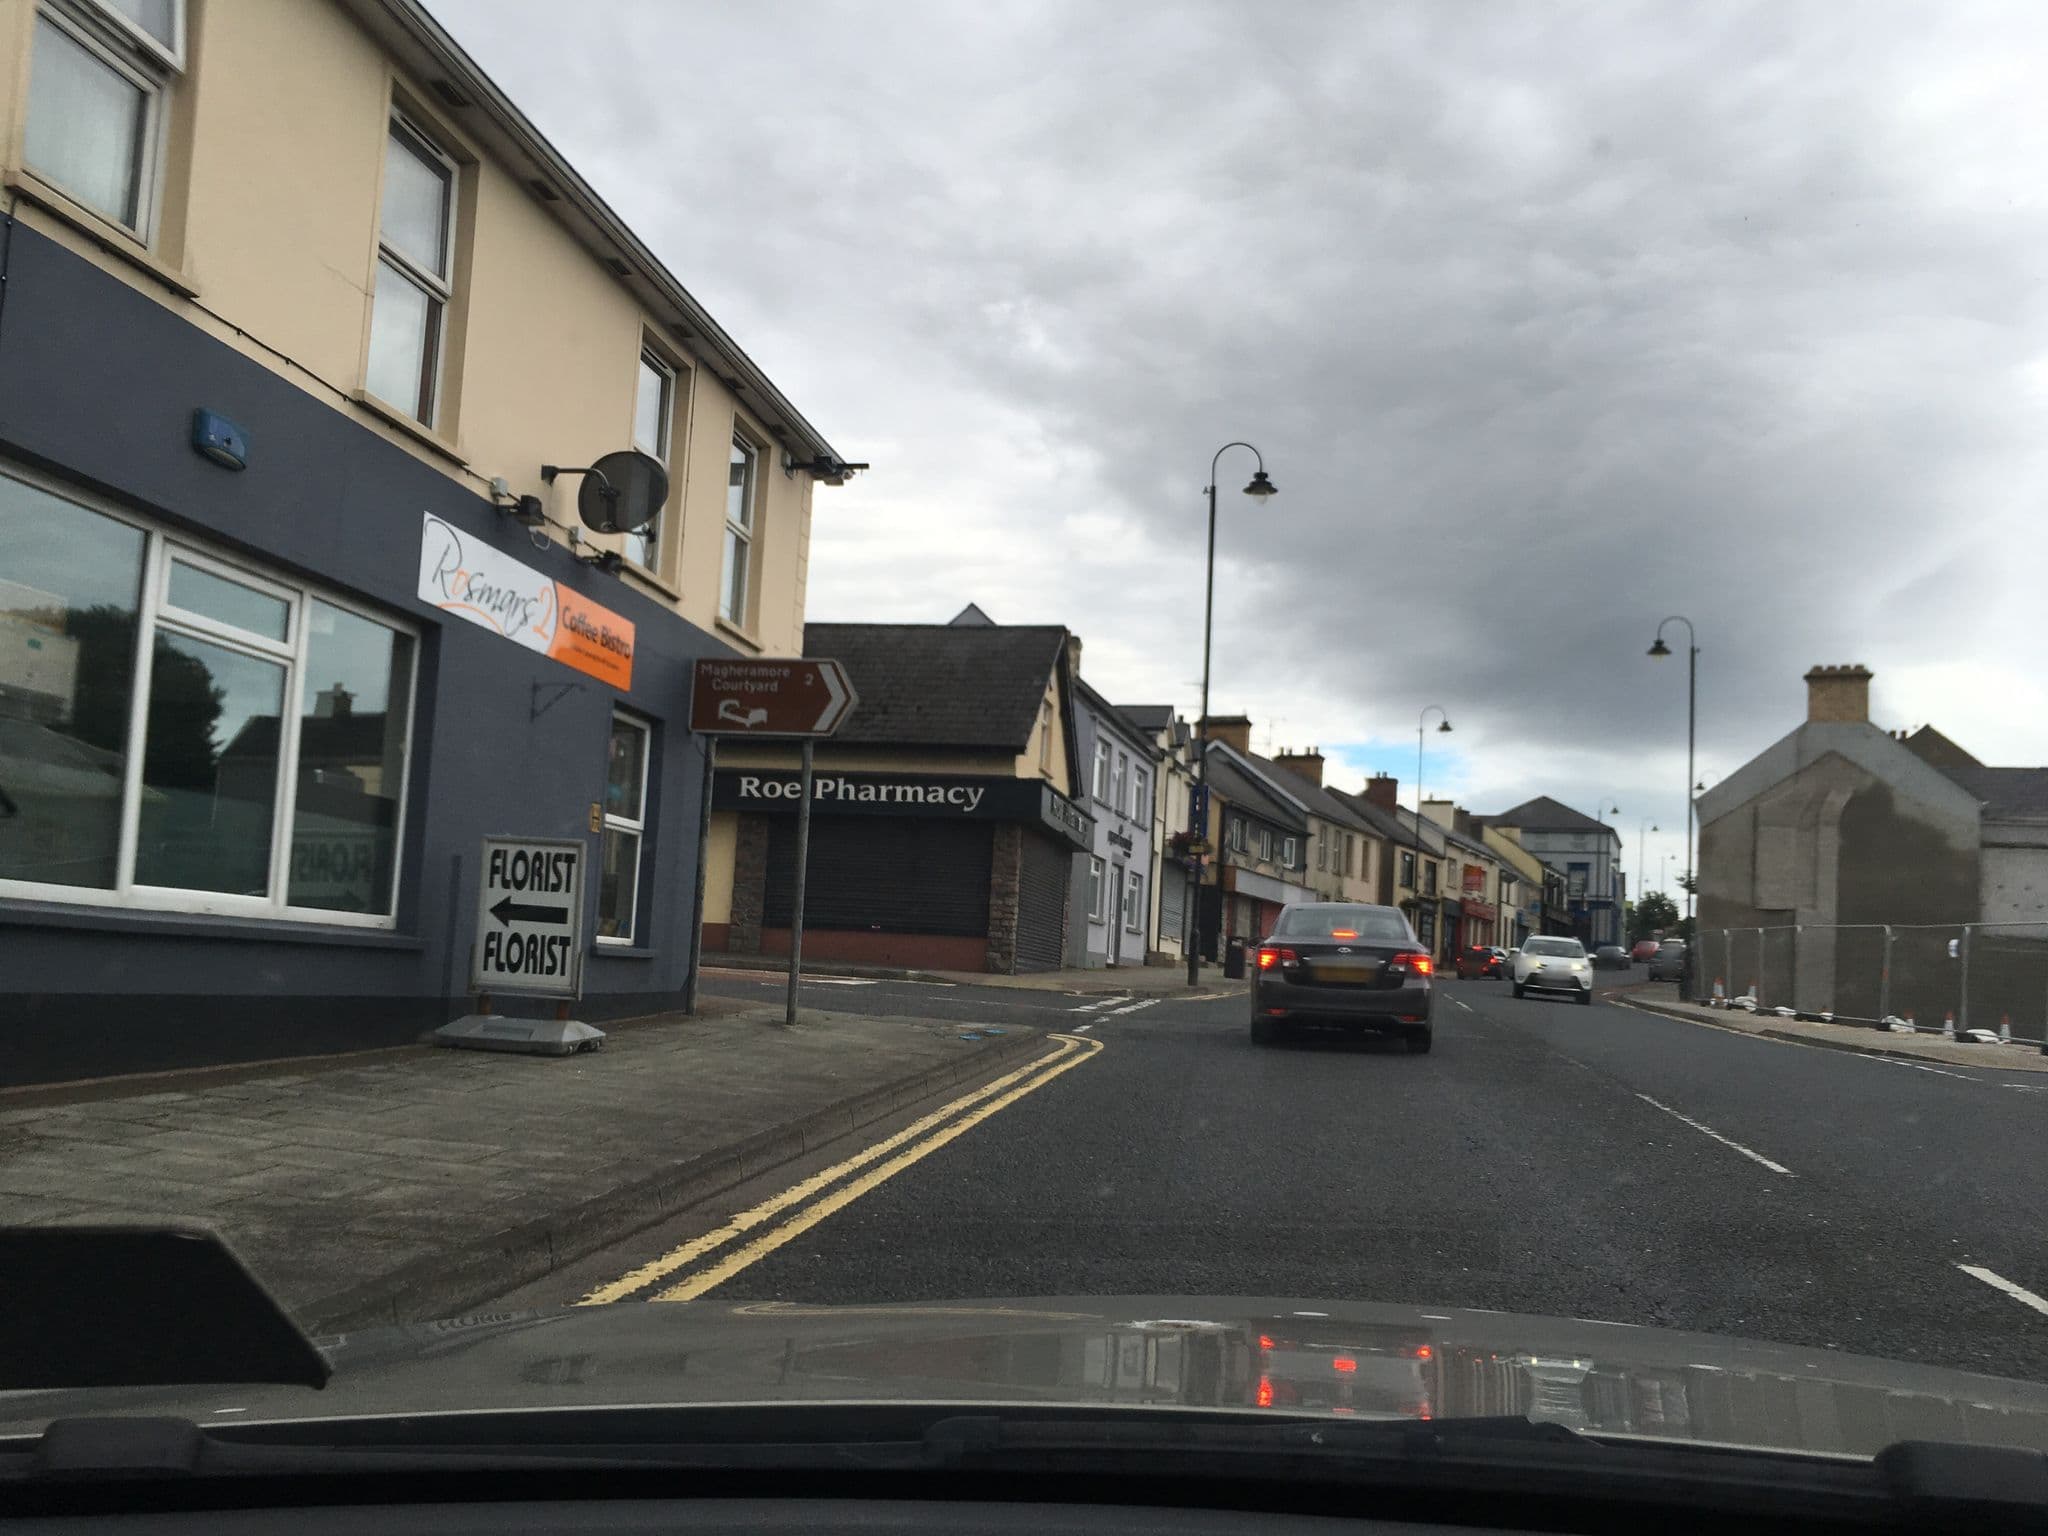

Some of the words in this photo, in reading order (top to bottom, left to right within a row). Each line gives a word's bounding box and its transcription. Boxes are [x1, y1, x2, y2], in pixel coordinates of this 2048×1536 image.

[562, 605, 598, 644] Coffee
[600, 625, 632, 660] Bistro
[711, 677, 779, 694] Courtyard
[738, 776, 802, 800] Roe
[814, 777, 985, 812] Pharmacy
[489, 849, 576, 893] FLORIST
[483, 931, 571, 977] FLORIST
